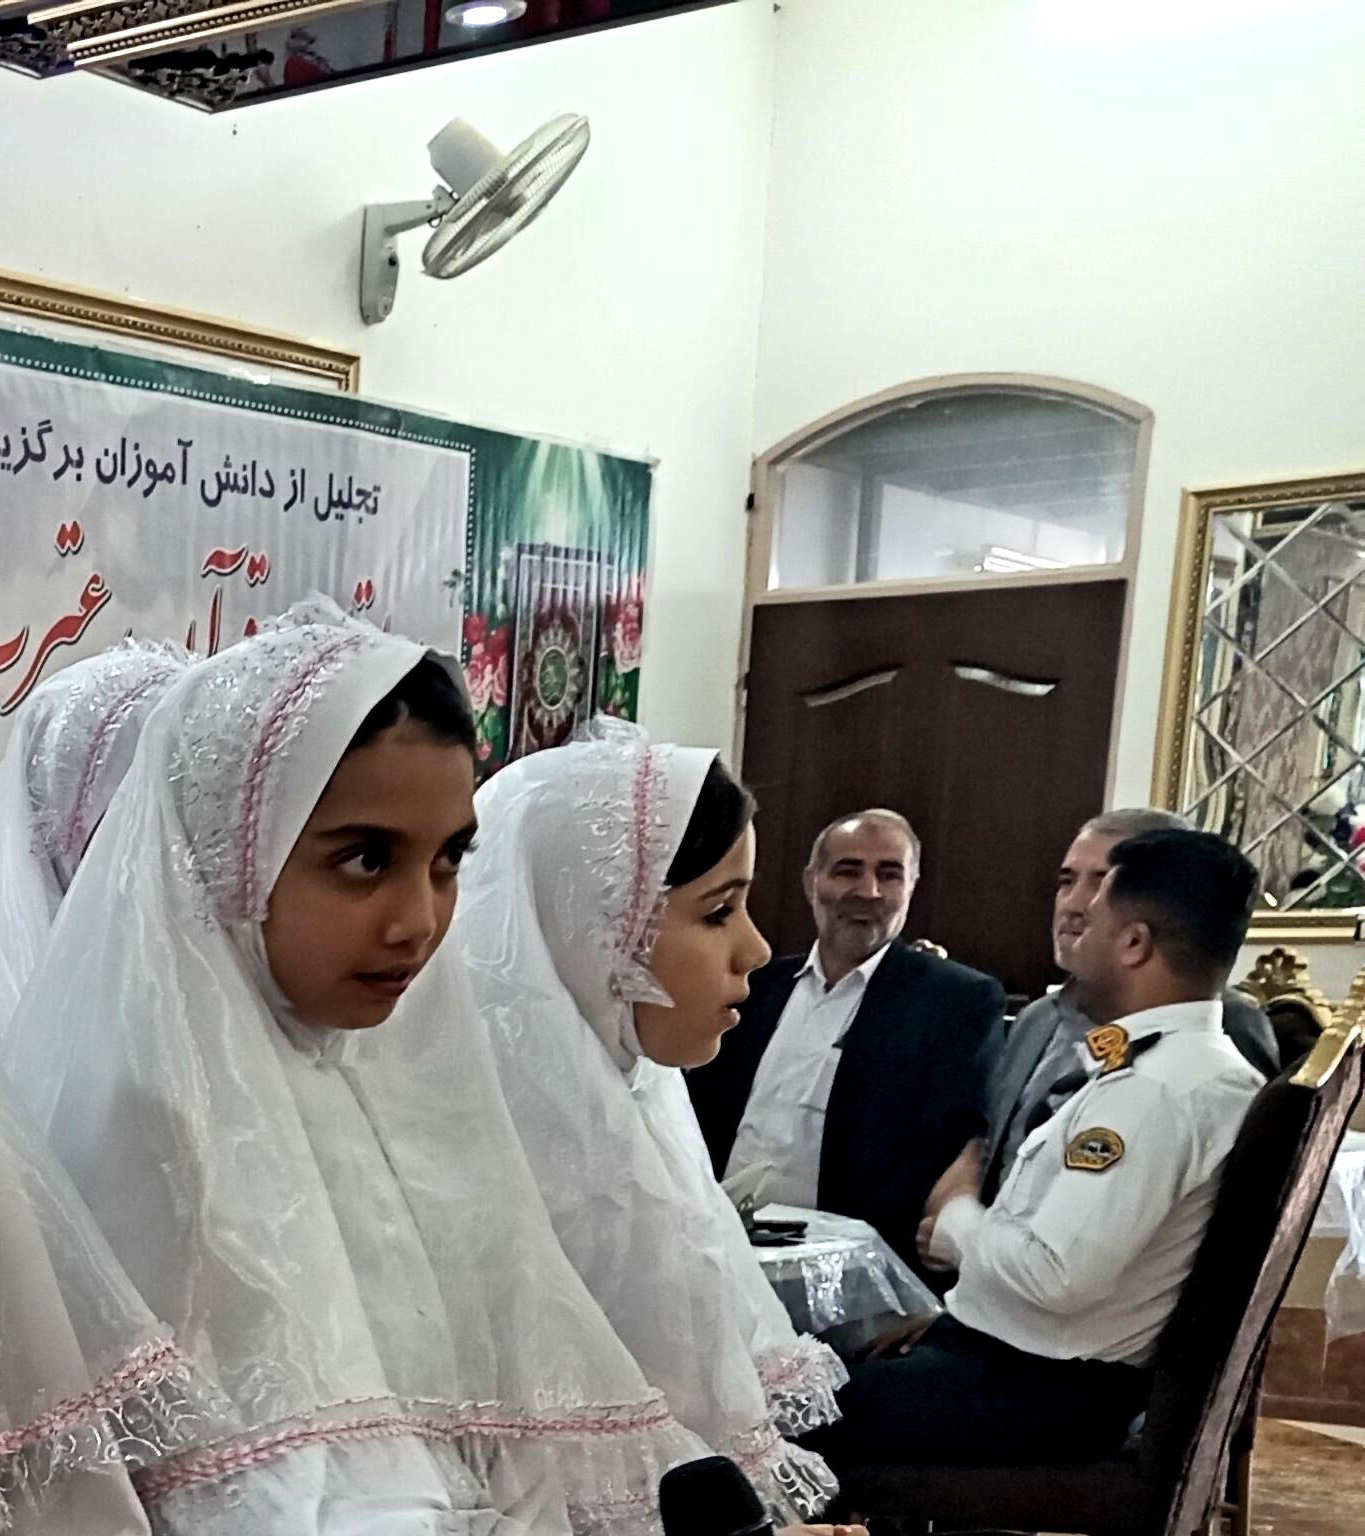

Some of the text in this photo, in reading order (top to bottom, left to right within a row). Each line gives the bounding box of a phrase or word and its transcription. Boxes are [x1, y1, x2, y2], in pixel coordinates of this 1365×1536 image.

[94, 436, 194, 499] آموزان
[200, 454, 276, 508] دانش
[283, 467, 306, 512] از
[313, 472, 382, 524] تجلیل
